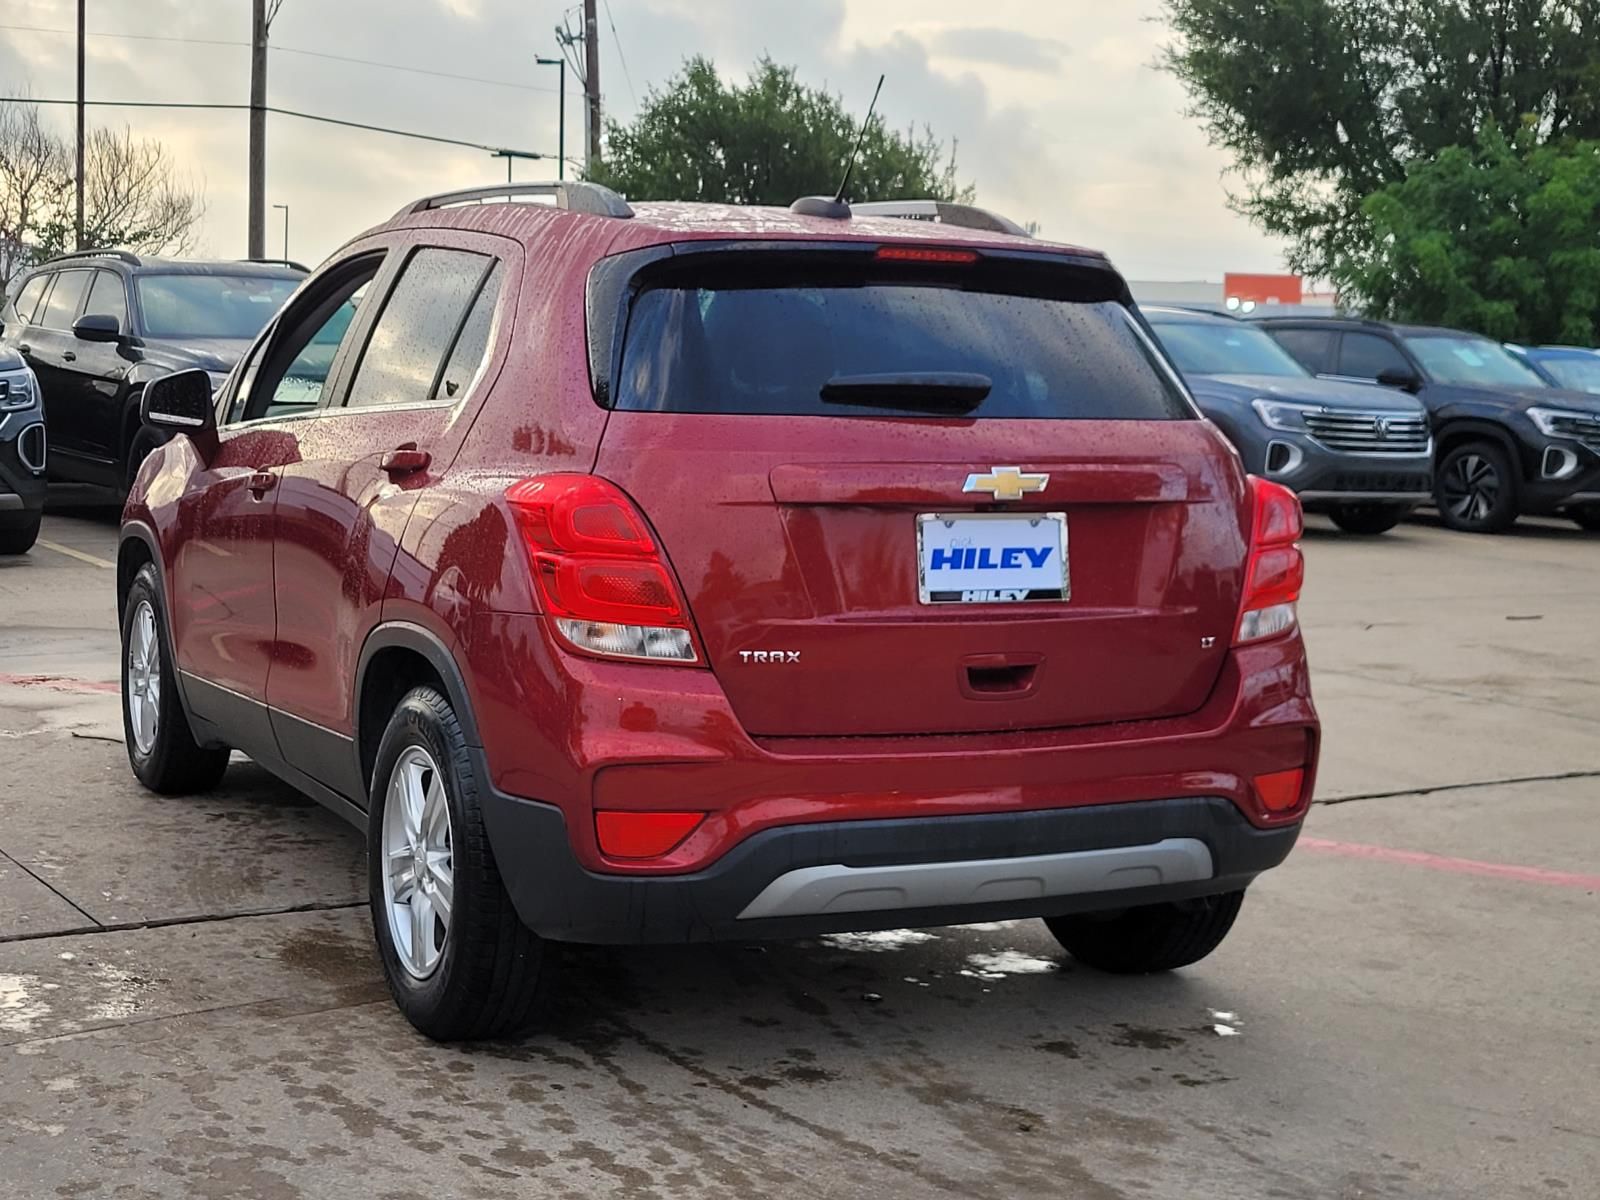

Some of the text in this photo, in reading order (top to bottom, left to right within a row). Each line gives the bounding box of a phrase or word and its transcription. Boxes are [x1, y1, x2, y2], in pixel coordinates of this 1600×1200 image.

[930, 547, 1053, 570] HILEY
[961, 589, 1030, 602] HILEY
[739, 650, 801, 663] TRAX
